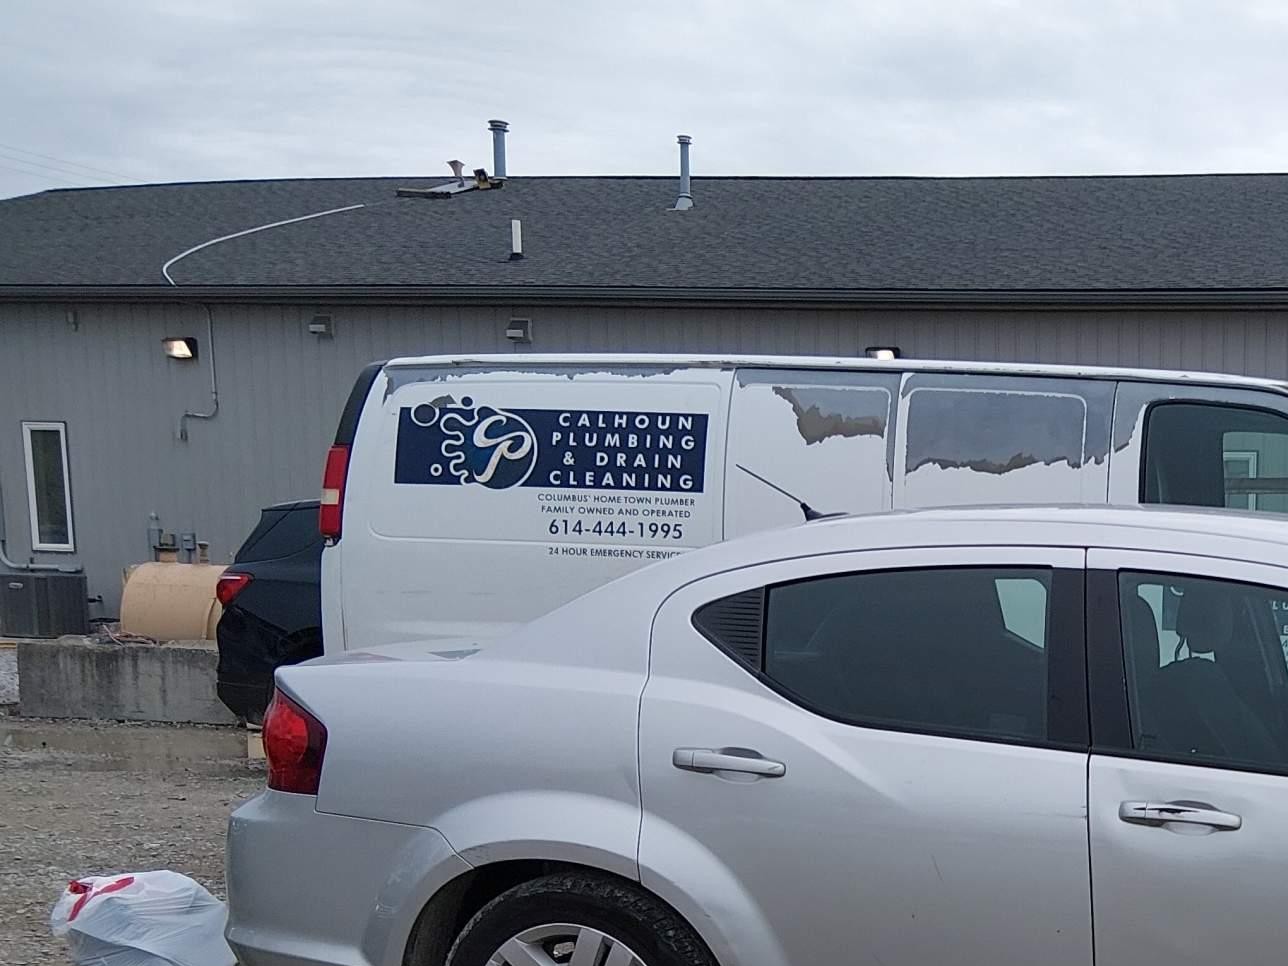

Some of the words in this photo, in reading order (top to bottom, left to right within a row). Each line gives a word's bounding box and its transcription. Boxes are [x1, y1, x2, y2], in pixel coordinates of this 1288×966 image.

[558, 413, 693, 430] CALHOUN
[552, 432, 695, 450] PLUMBING
[563, 451, 575, 466] &
[596, 452, 682, 469] DRAIN
[549, 470, 693, 490] CLEANING
[655, 497, 695, 507] PLUMBER
[541, 505, 576, 514] FAMILY
[578, 506, 615, 516] OWNED
[617, 508, 640, 517] AND
[642, 509, 691, 519] OPERATED
[548, 519, 683, 540] 614-444-1995
[548, 547, 559, 556] 24
[562, 548, 588, 557] HOUR
[590, 549, 643, 559] EMERGENCY
